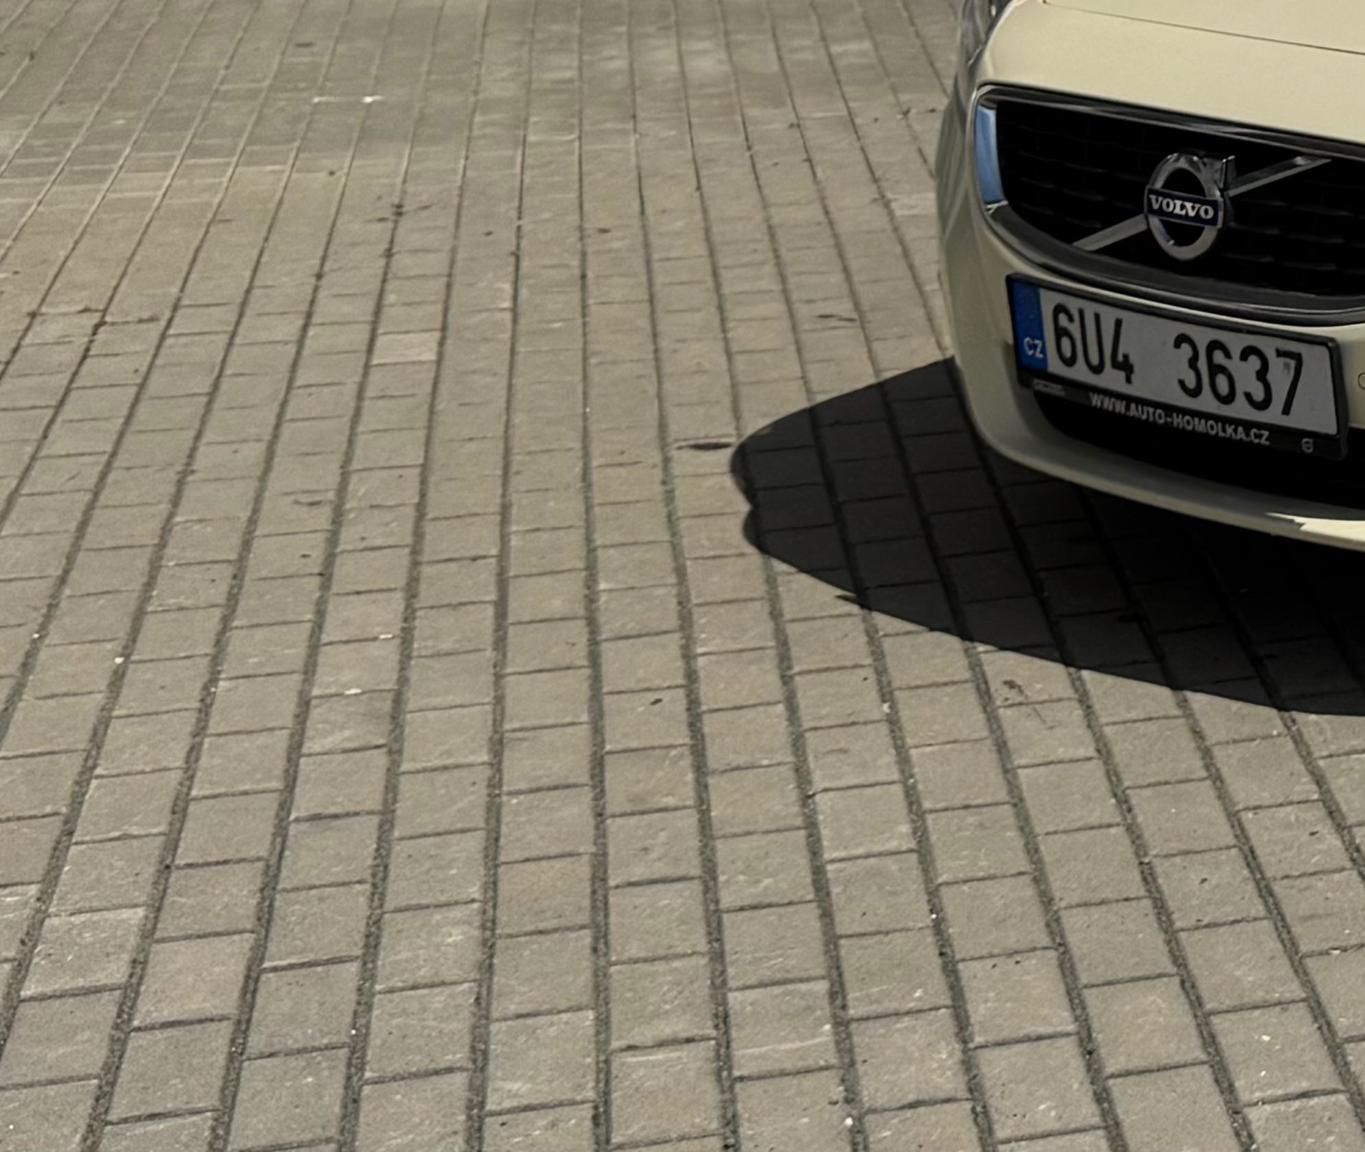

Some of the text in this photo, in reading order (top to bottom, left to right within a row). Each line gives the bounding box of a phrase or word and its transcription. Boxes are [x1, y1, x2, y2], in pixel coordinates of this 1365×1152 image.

[1149, 194, 1215, 220] VOLVO
[1023, 336, 1044, 359] CZ
[1052, 302, 1303, 417] 6U4 3637
[1089, 393, 1271, 446] WWW.AUTO-HOMOLKA.CZ
